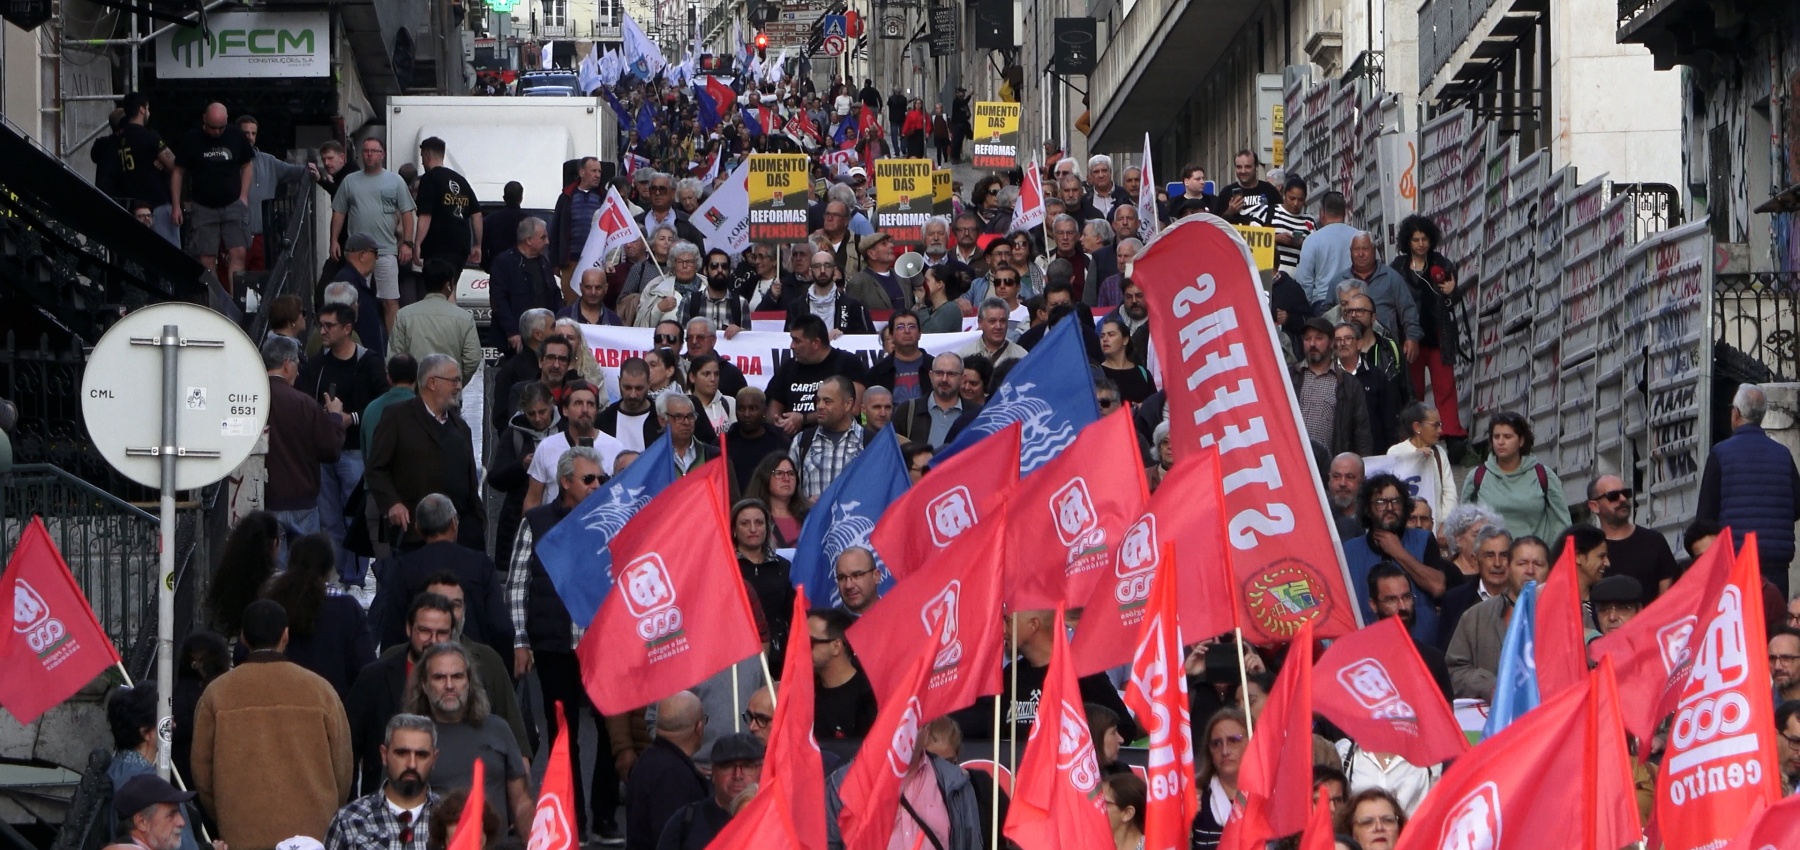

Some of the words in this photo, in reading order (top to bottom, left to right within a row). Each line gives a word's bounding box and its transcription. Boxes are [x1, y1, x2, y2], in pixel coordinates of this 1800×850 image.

[219, 29, 315, 55] FCM
[976, 105, 1018, 117] AUMENTO
[987, 117, 1006, 128] DAS
[974, 144, 1016, 156] REFORMAS
[749, 158, 806, 173] AUMENTO
[877, 163, 930, 178] AUMENTO
[766, 173, 791, 187] DAS
[893, 178, 916, 192] DAS
[1243, 195, 1262, 206] NIKE
[750, 209, 807, 223] REFORMAS
[758, 222, 807, 239] PENSÕES
[90, 389, 115, 399] CML
[230, 406, 257, 415] 6531
[792, 402, 816, 412] LUTA
